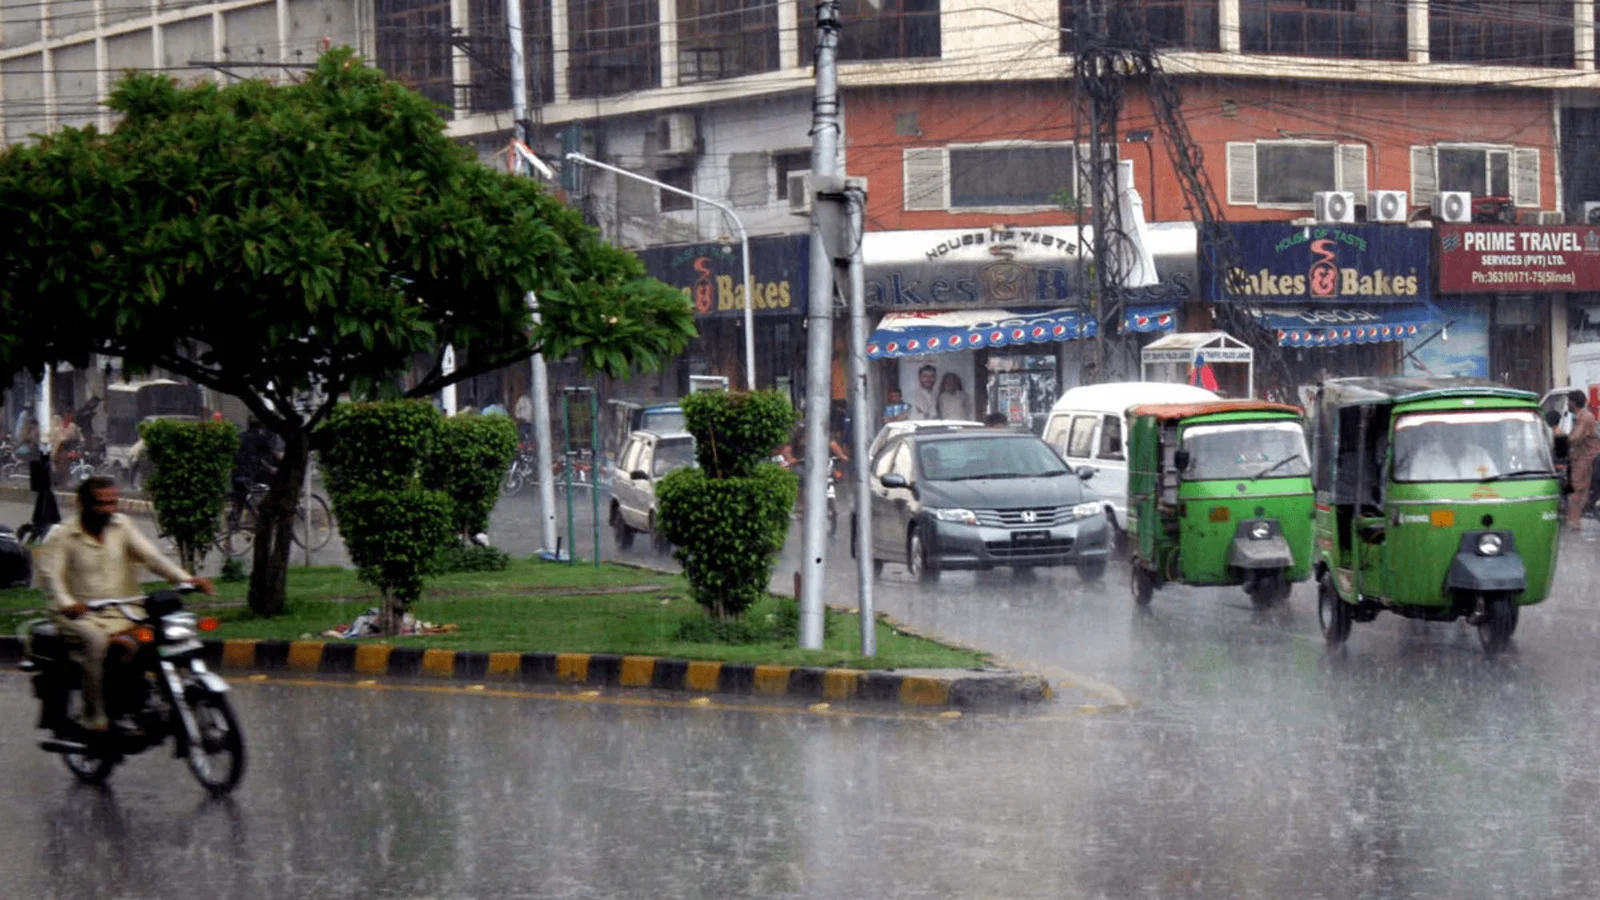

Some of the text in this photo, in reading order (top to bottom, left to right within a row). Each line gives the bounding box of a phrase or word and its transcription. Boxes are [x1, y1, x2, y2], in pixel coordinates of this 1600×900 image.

[926, 232, 985, 261] HOUSE
[1021, 231, 1078, 255] TASTE
[1463, 232, 1582, 251] PRIME TRAVEL
[1481, 255, 1522, 266] SERVICES
[1524, 255, 1546, 267] (PVT)
[1341, 268, 1418, 296] Bakes
